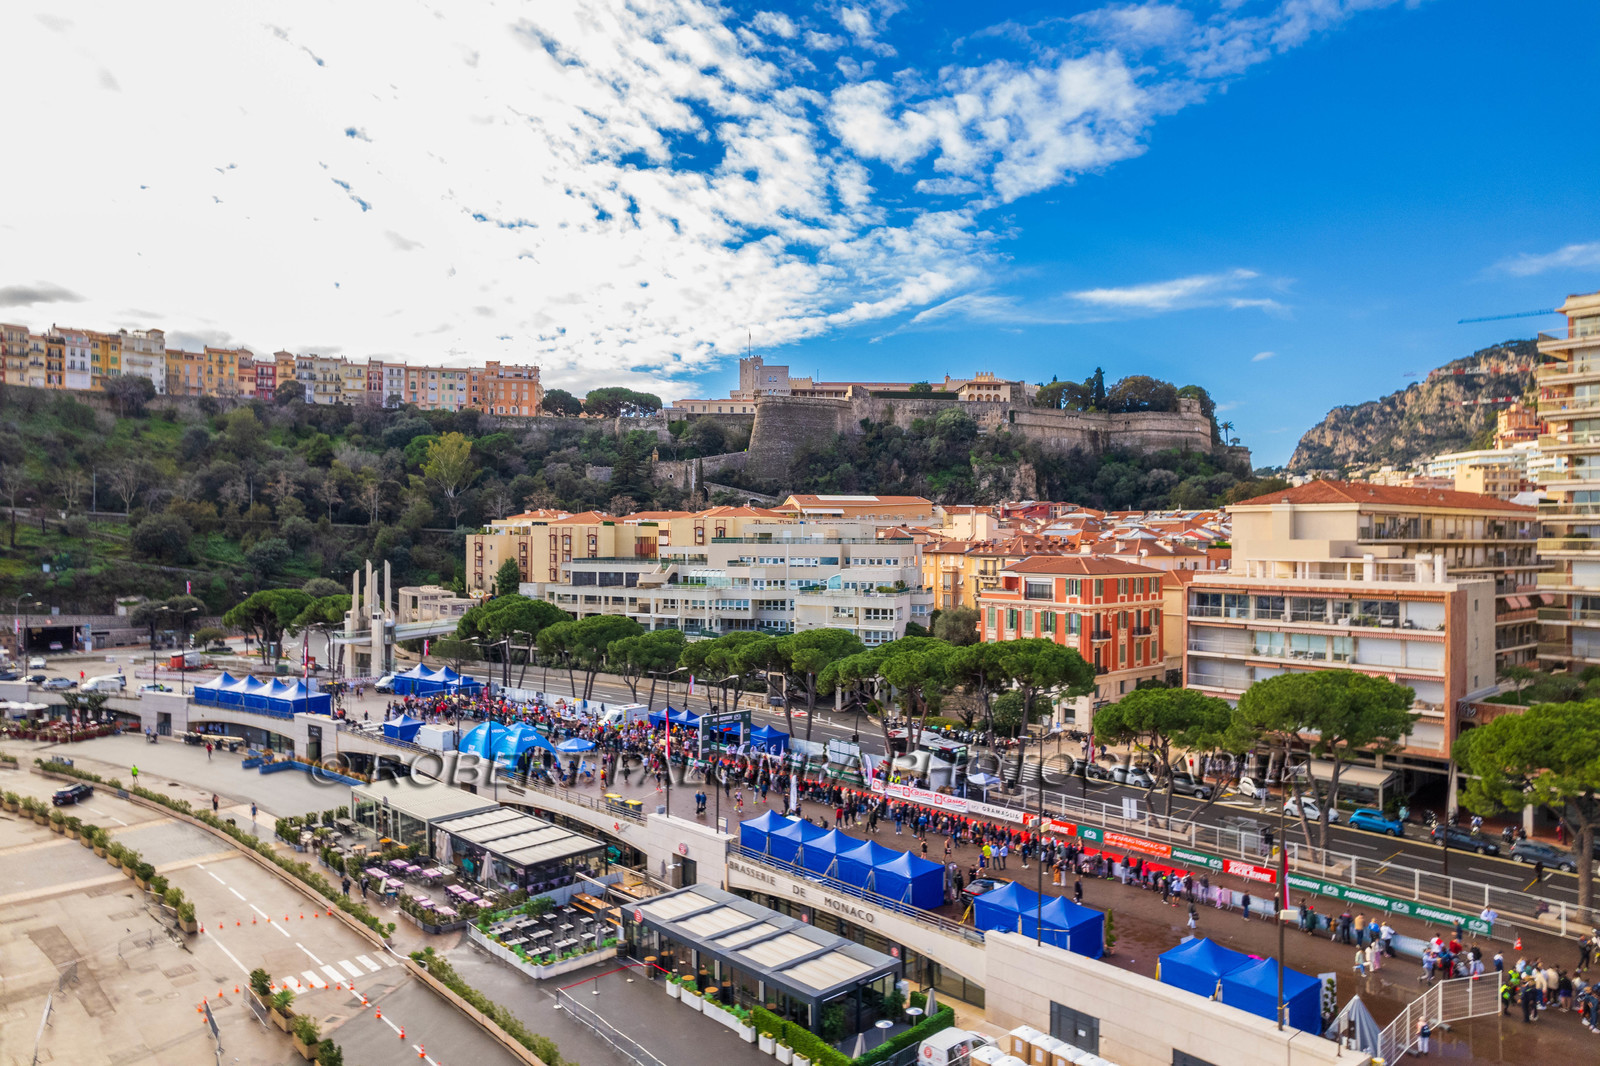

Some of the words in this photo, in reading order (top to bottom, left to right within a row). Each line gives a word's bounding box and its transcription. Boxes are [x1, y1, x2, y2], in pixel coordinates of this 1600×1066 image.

[910, 788, 933, 799] Casino
[942, 796, 967, 806] Casino
[729, 860, 776, 886] BRASSERIE
[792, 884, 806, 898] DE
[824, 896, 875, 923] MONACO
